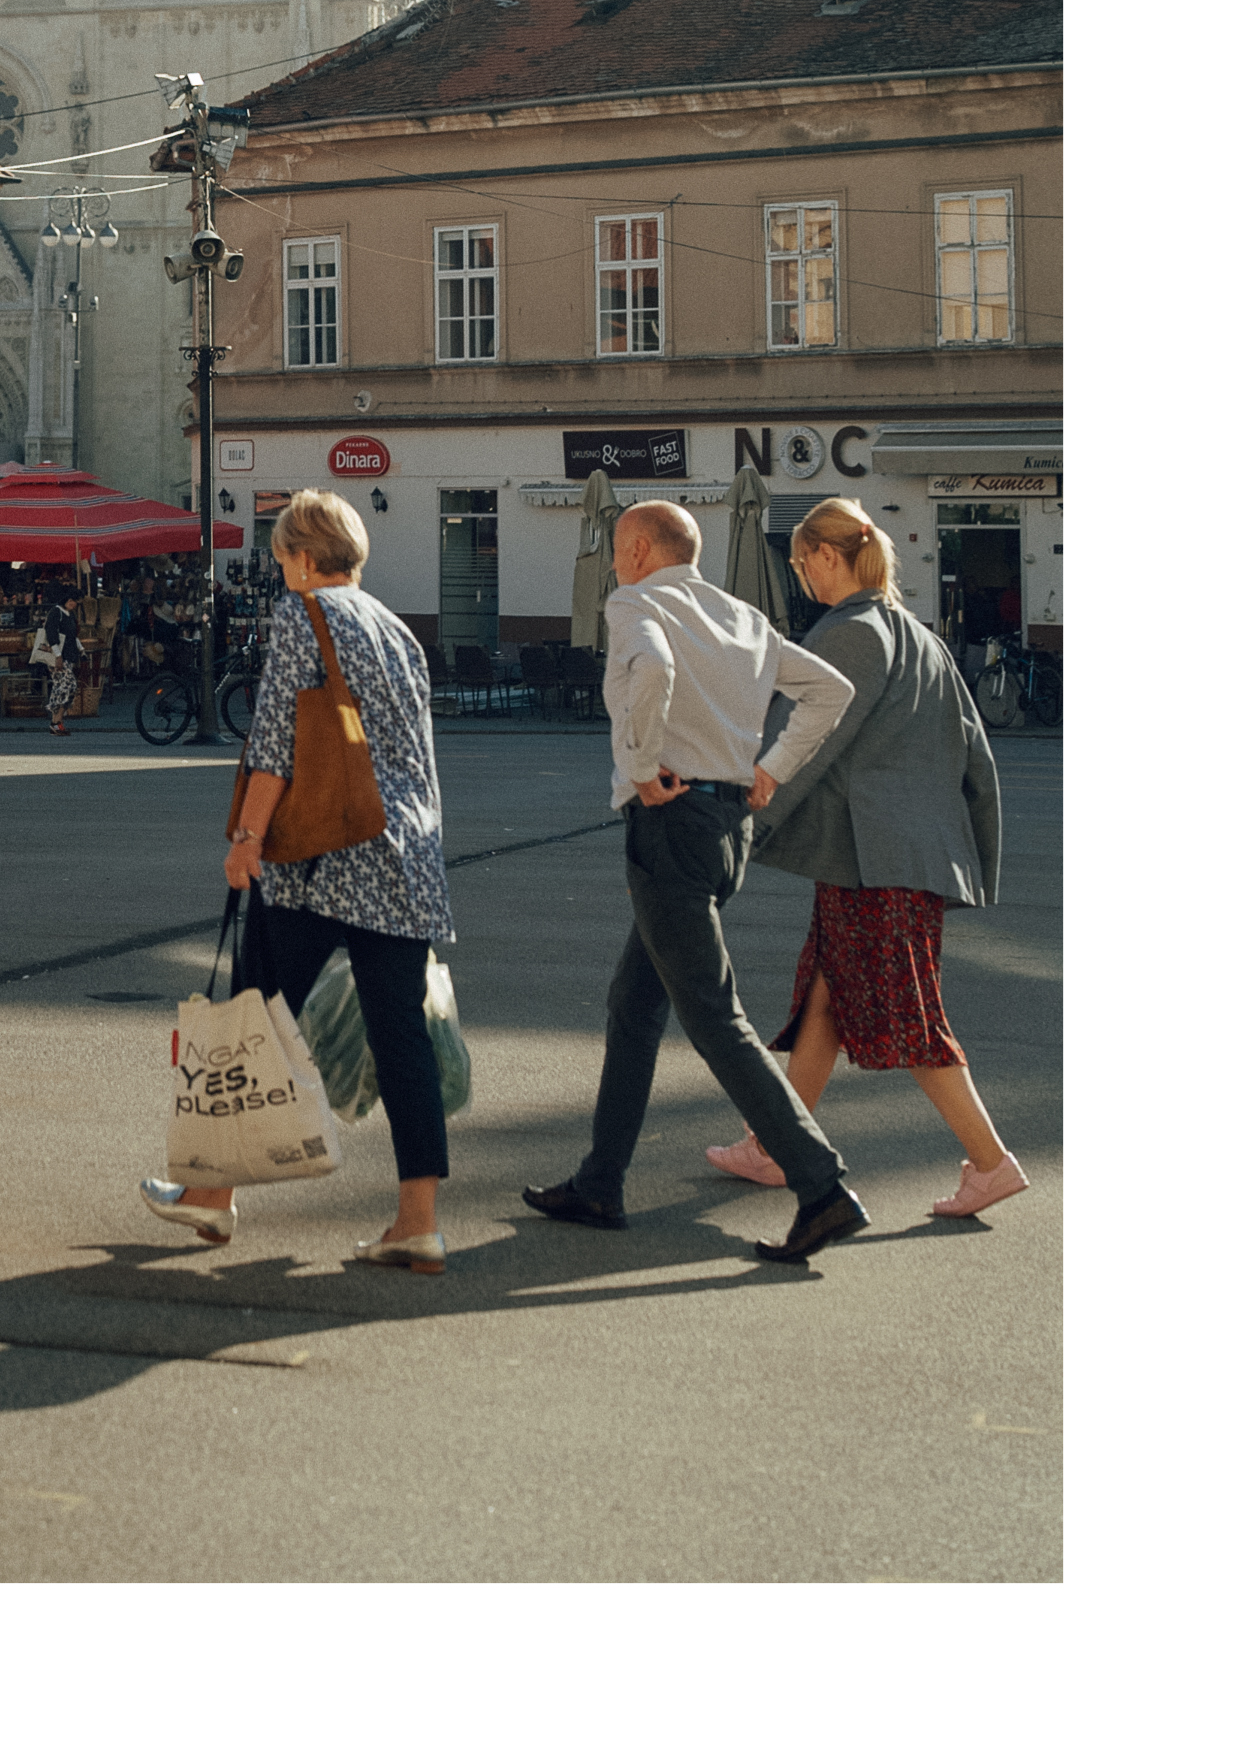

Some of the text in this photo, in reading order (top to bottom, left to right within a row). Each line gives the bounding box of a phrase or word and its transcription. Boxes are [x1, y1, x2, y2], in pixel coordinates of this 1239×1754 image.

[570, 449, 601, 459] UKUSNO
[620, 449, 648, 459] DOBRO
[653, 440, 678, 457] FAST
[734, 428, 772, 477] N
[830, 426, 868, 478] C
[336, 450, 381, 469] Dinara
[655, 452, 680, 467] FOOD
[971, 474, 1046, 491] Kumica
